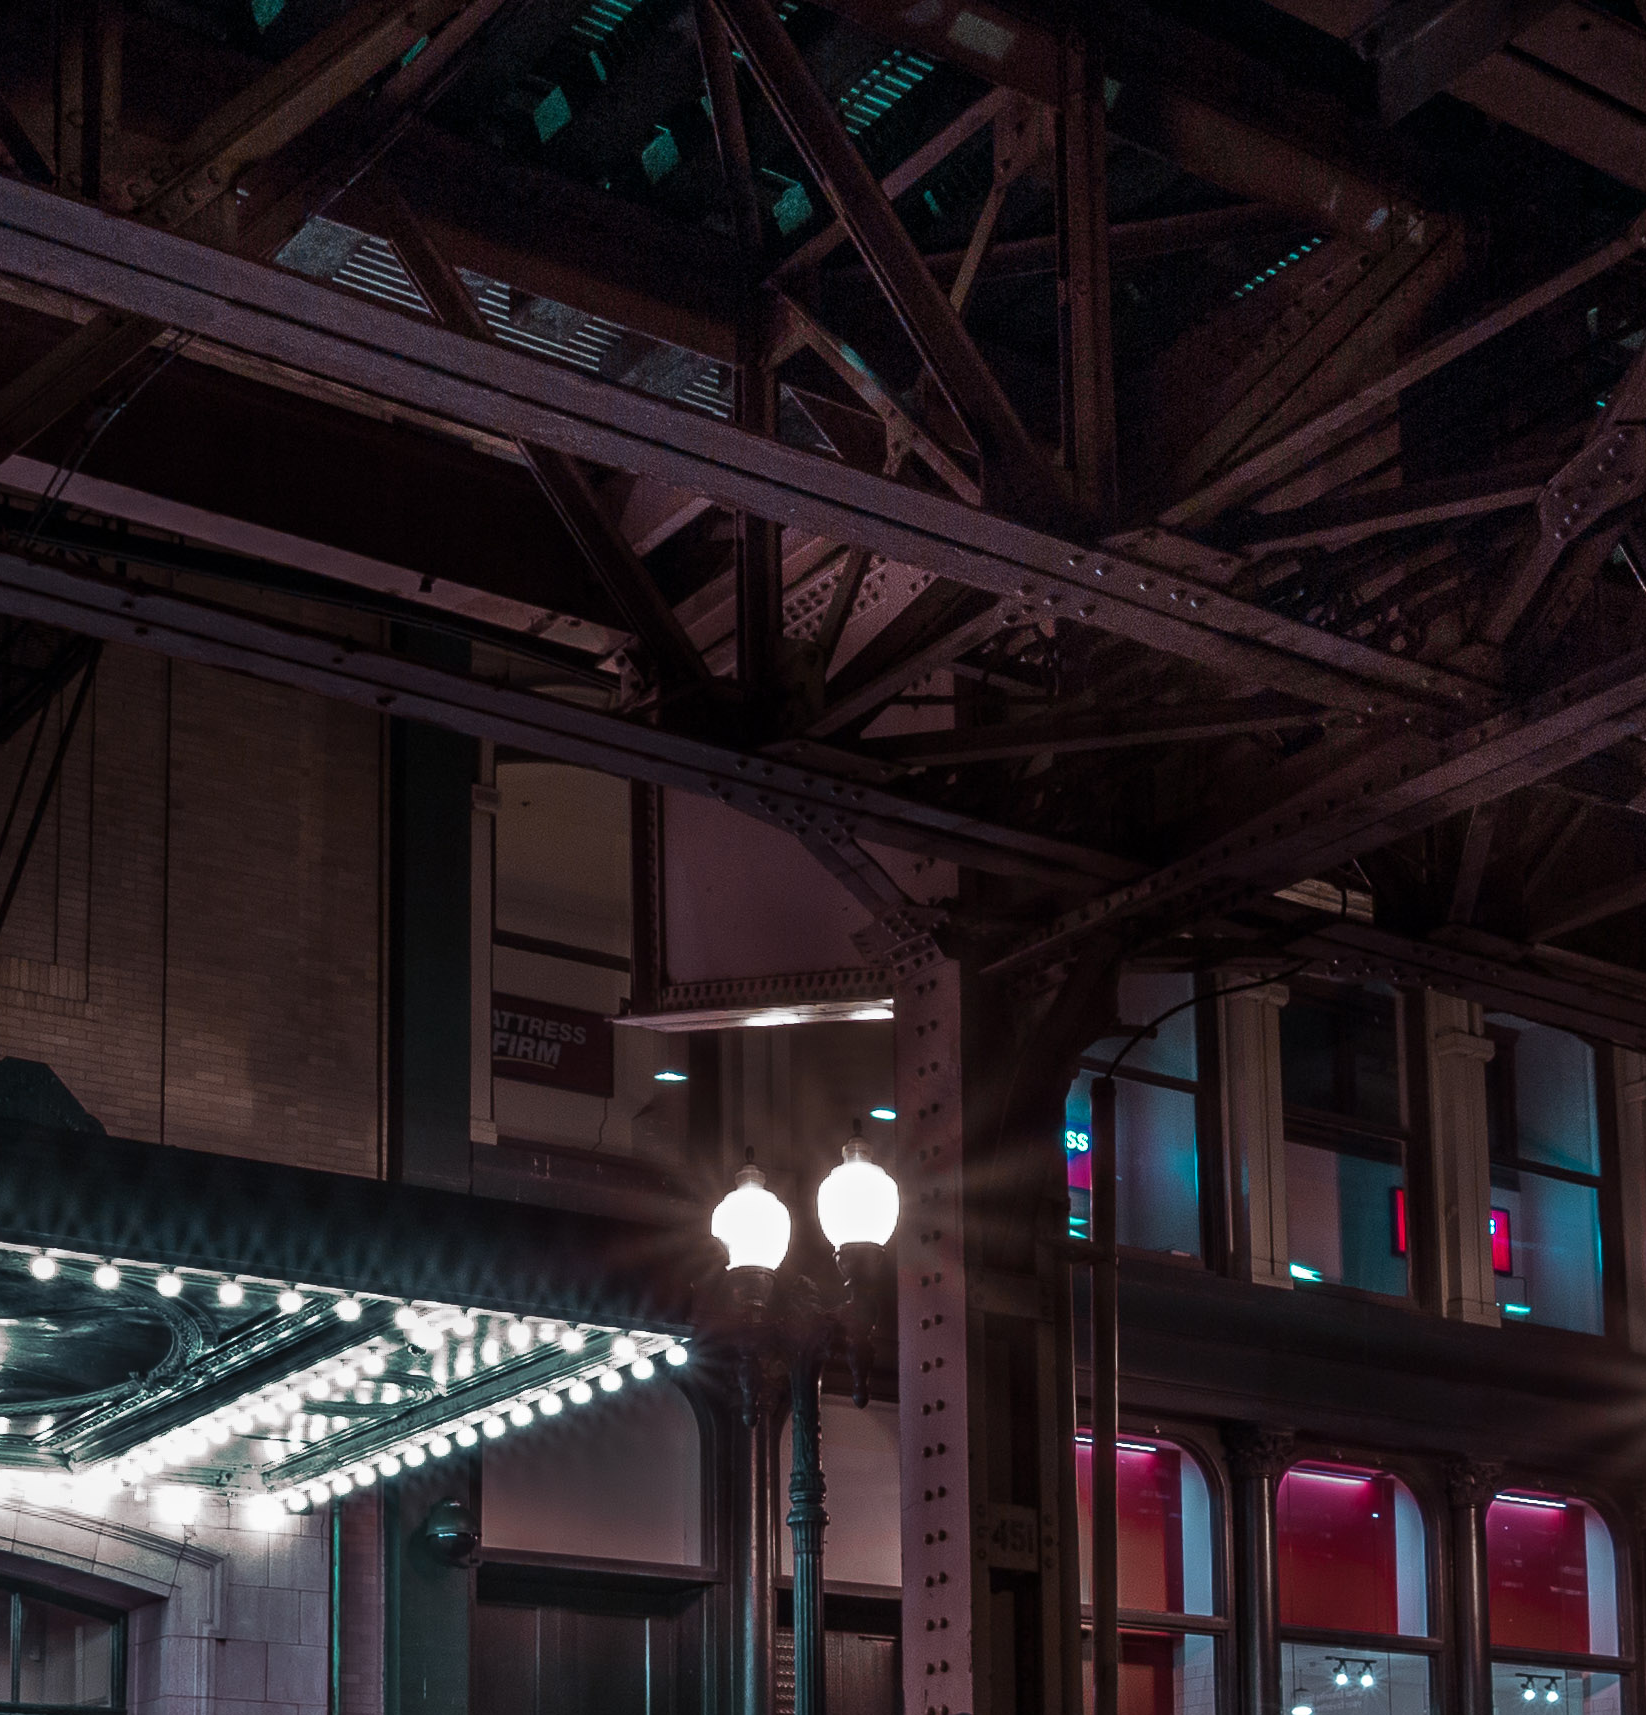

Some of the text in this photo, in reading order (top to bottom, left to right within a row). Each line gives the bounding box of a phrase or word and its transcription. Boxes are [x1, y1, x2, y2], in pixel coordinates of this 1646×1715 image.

[493, 1008, 587, 1046] ATTRESS
[493, 1030, 562, 1066] FIRM
[1065, 1129, 1090, 1153] SS
